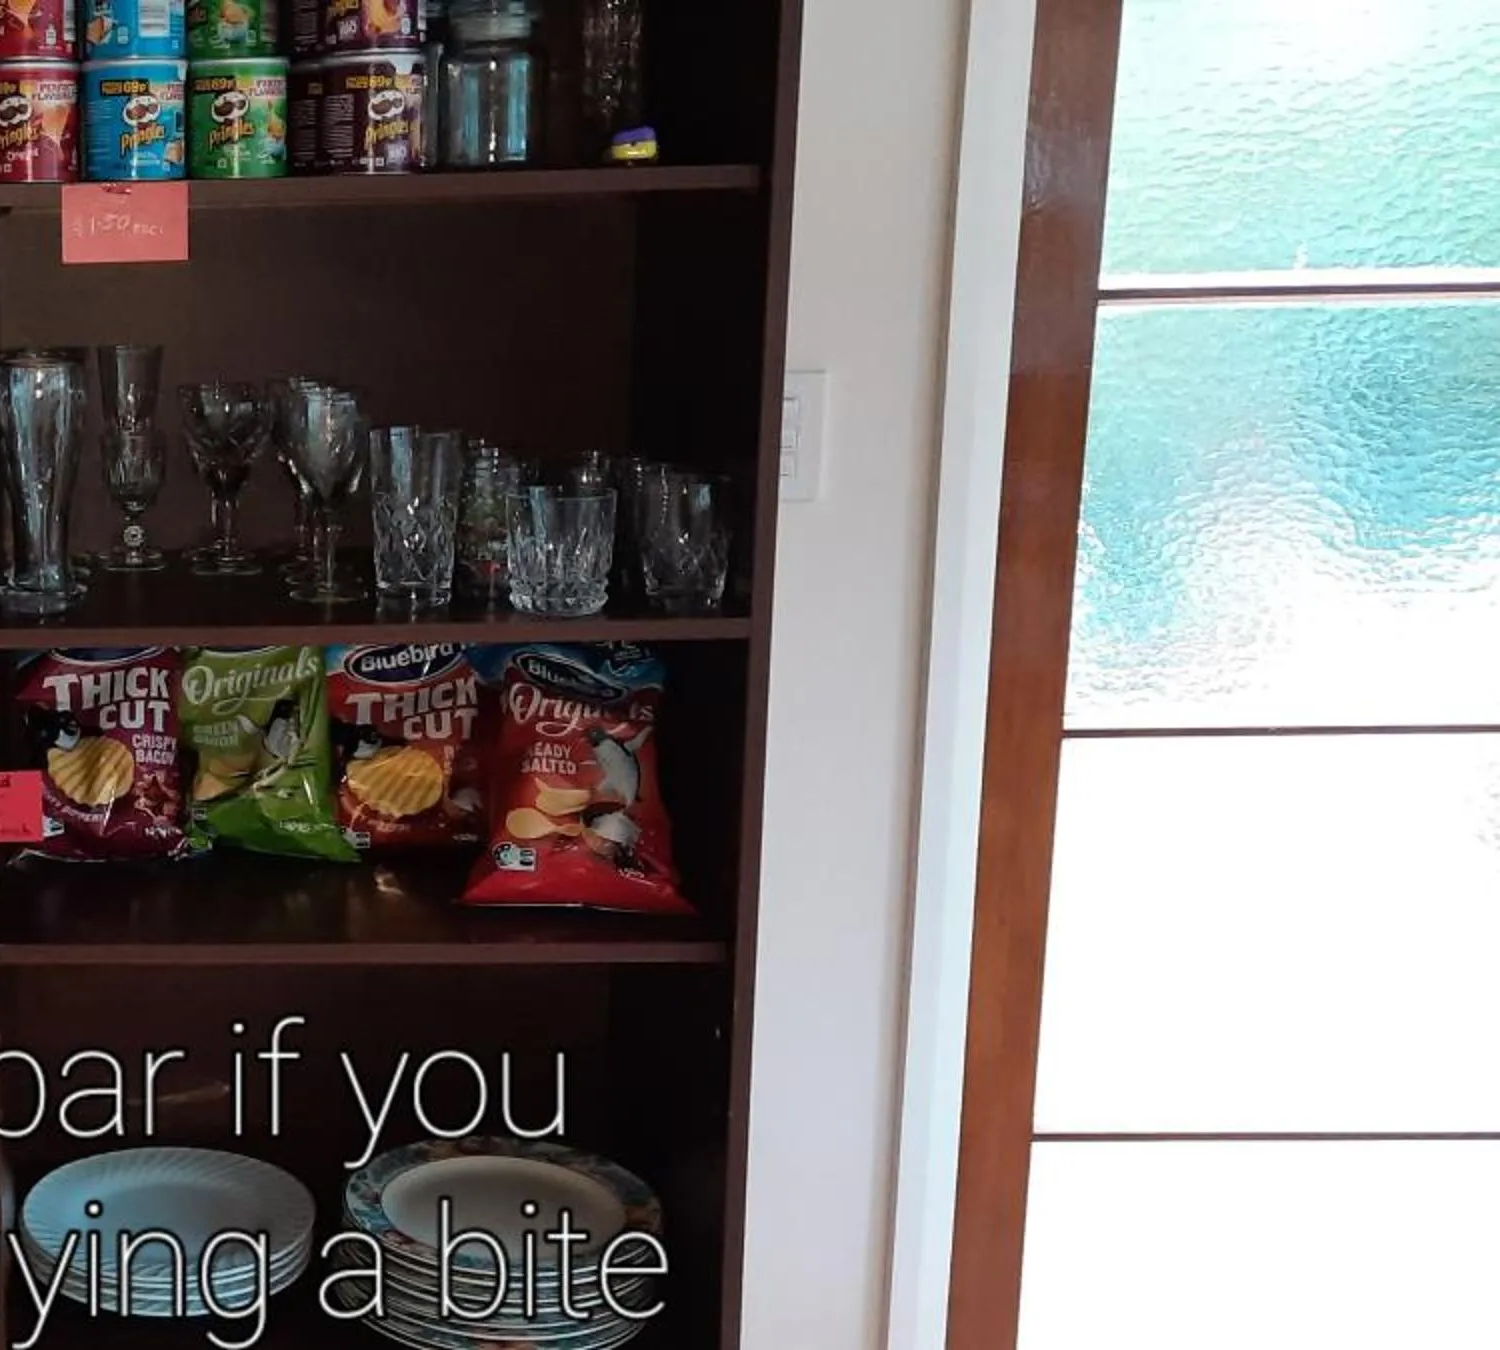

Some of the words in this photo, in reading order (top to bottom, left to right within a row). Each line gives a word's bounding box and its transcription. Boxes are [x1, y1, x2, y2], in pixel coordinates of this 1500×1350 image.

[119, 121, 165, 157] Pringles
[208, 117, 255, 152] Pringles
[359, 645, 452, 673] Bluebird
[42, 667, 171, 712] THICK
[181, 652, 320, 716] Originals
[98, 700, 172, 732] CUT
[346, 679, 478, 725] THICK
[132, 732, 178, 751] CRISPY
[402, 708, 480, 741] CUT
[526, 741, 572, 759] EADY
